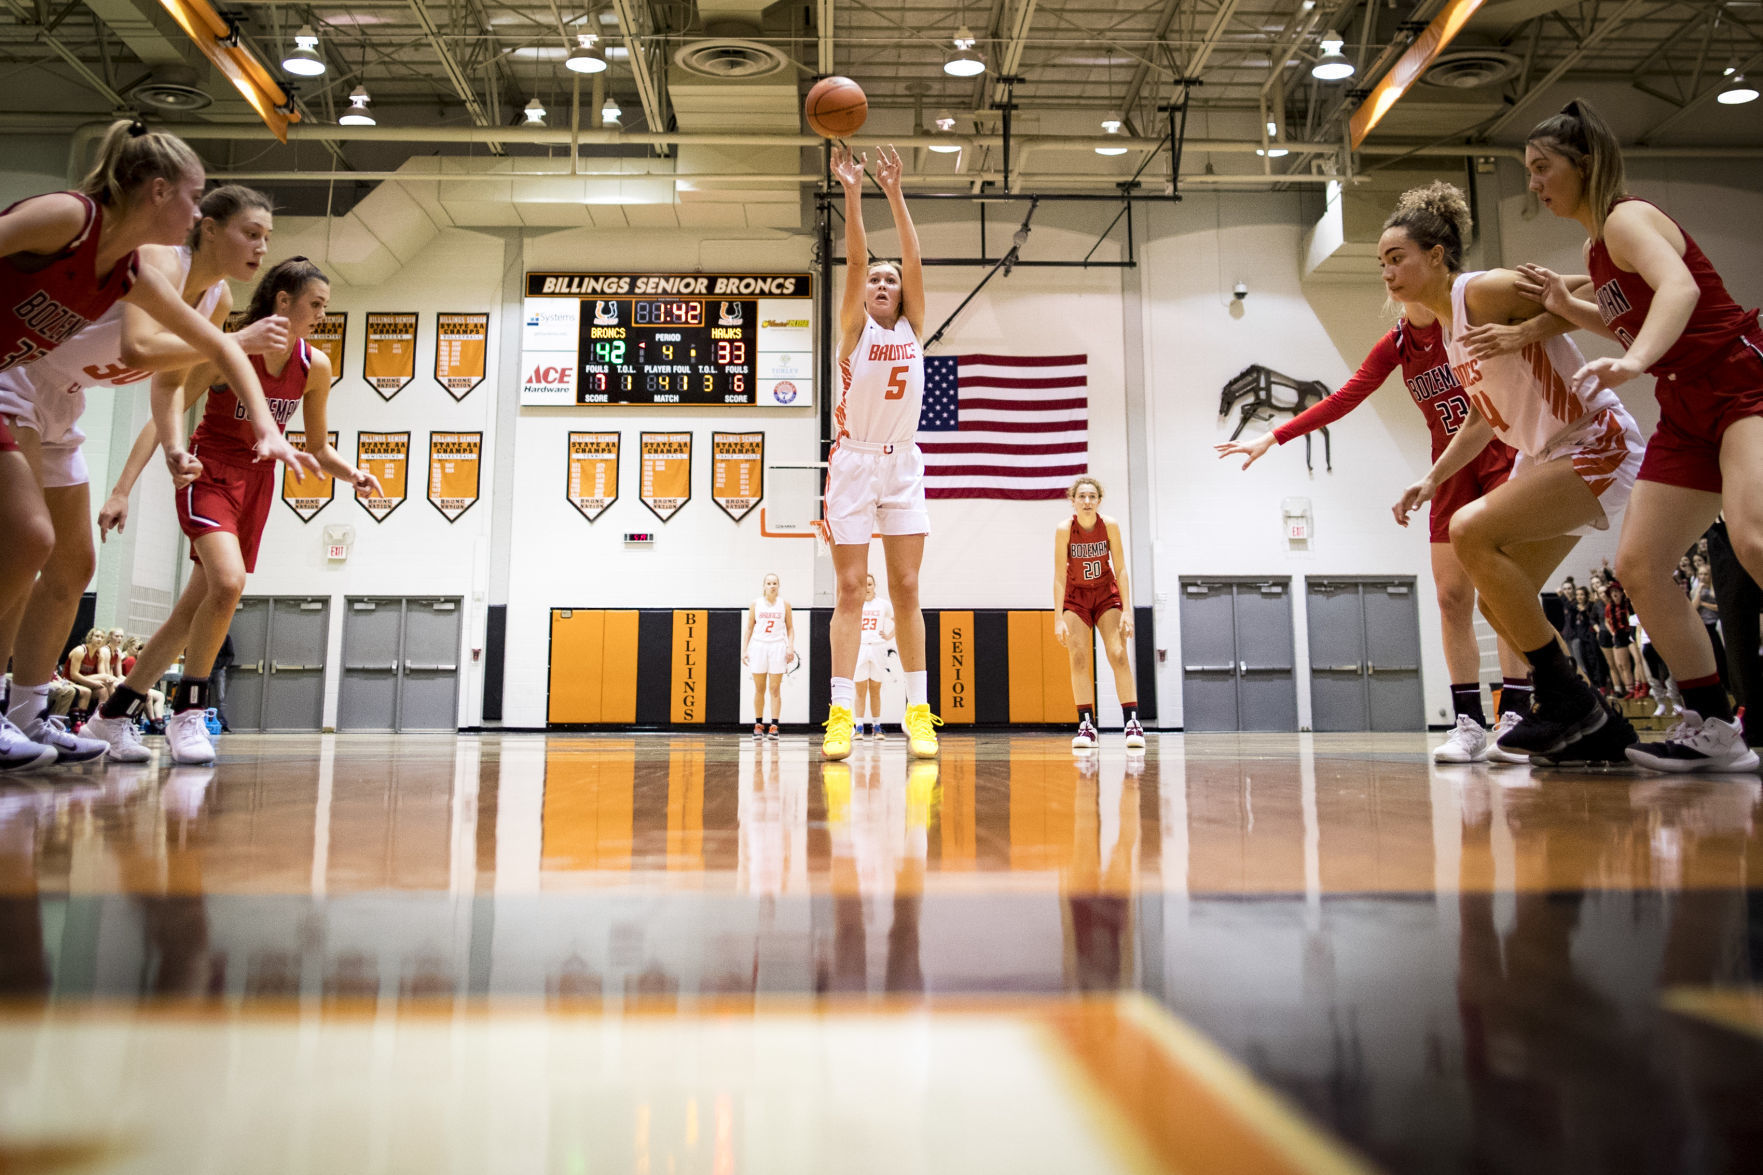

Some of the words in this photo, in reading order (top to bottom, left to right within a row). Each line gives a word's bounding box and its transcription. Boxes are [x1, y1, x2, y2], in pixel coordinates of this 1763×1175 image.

[542, 277, 630, 294] BILLINGS
[634, 277, 708, 294] SENIOR
[714, 278, 796, 294] BRONCS
[660, 302, 700, 324] 1:42
[590, 328, 626, 338] BRONCS
[656, 333, 681, 342] PERIOD
[712, 328, 742, 340] HAWKS
[596, 340, 626, 364] 42
[662, 345, 674, 360] 4
[718, 342, 745, 364] 33
[526, 364, 573, 384] ACE
[586, 365, 608, 374] FOULS
[616, 365, 636, 374] T.O.L.
[644, 365, 671, 374] PLAYER
[673, 365, 691, 374] FOUL
[698, 366, 718, 374] T.O.L.
[725, 366, 748, 374] FOULS
[596, 374, 606, 390] 7
[704, 374, 714, 392] 3
[734, 374, 744, 392] 6
[884, 366, 909, 400] 5
[1408, 363, 1461, 402] BOZEM
[234, 398, 301, 424] BEMA
[1434, 395, 1470, 435] 23
[1292, 527, 1304, 536] EXIT
[330, 546, 344, 556] EXIT
[1071, 540, 1108, 558] BOZEMAN
[1083, 560, 1101, 580] 20
[765, 620, 774, 632] 2
[862, 618, 878, 630] 23
[683, 613, 696, 721] BILLINGS
[952, 628, 964, 708] SENIOR
